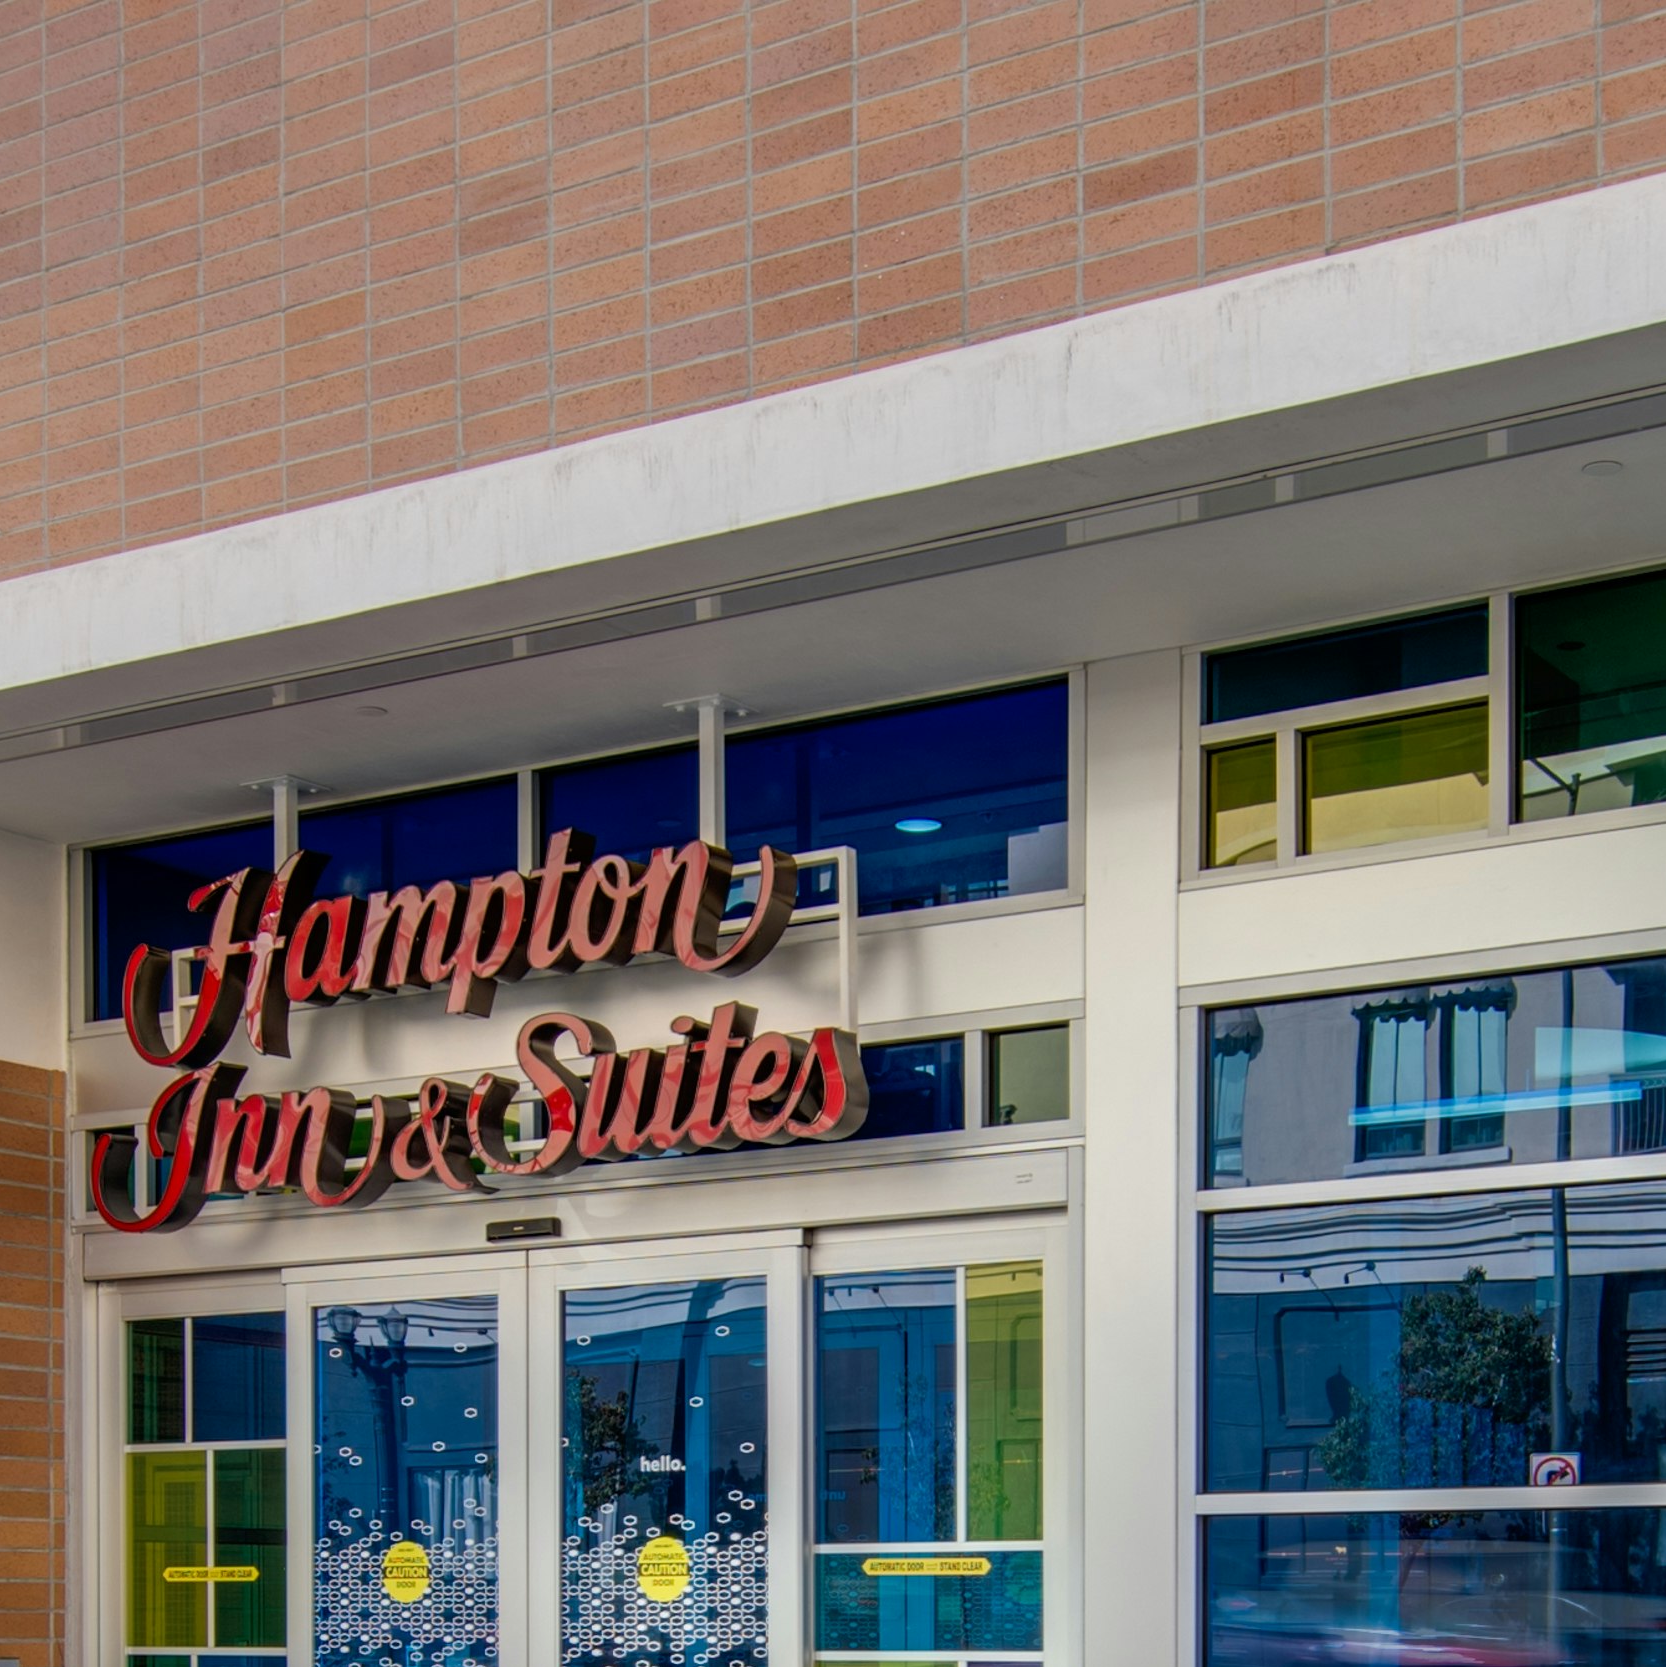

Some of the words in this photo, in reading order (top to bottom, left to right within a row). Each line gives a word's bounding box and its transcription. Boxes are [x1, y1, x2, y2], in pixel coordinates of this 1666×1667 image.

[123, 827, 797, 1070] Hampton
[91, 1062, 409, 1234] Inn
[391, 1077, 499, 1195] &
[467, 1000, 869, 1178] Suites
[640, 1454, 687, 1472] hello.
[643, 1553, 685, 1561] AUTOMATIC
[386, 1566, 428, 1578] CAUTION
[641, 1563, 688, 1576] CAUTION
[870, 1562, 906, 1571] AUTOMATIC
[907, 1562, 924, 1571] DOOR
[940, 1562, 961, 1571] STAND
[962, 1562, 983, 1571] CLEAR
